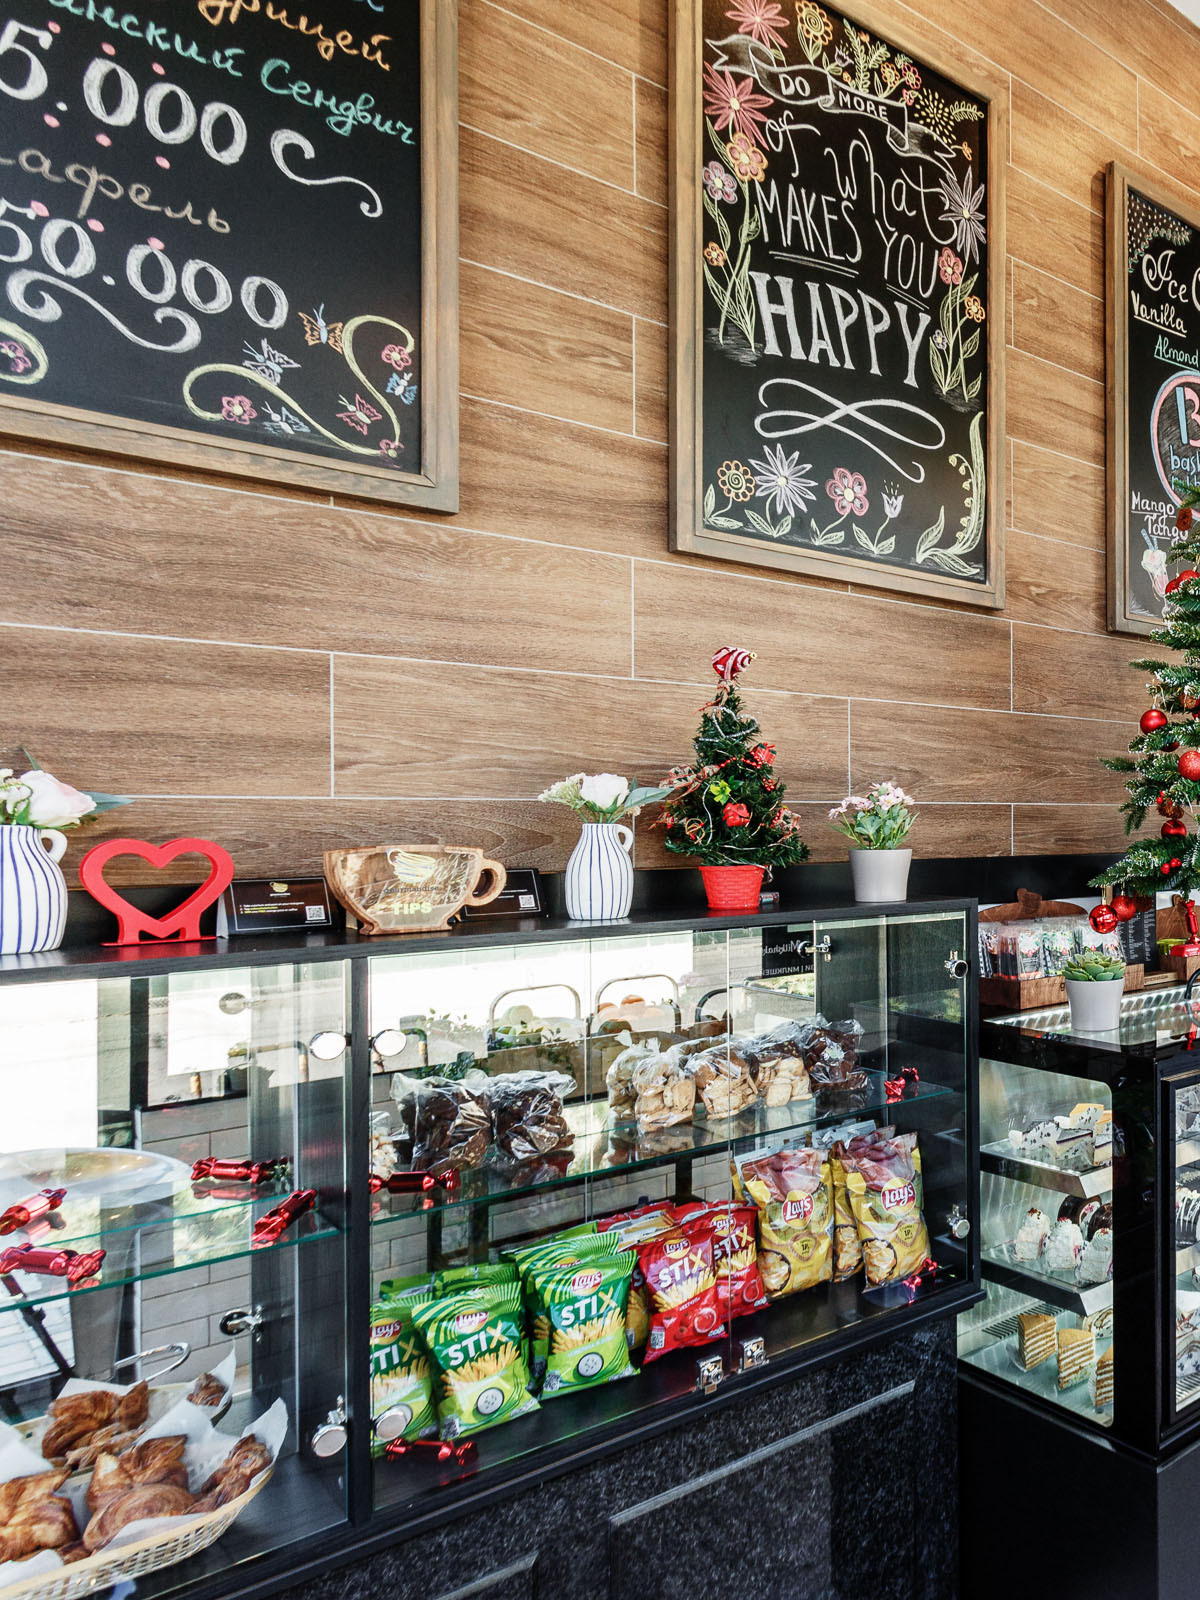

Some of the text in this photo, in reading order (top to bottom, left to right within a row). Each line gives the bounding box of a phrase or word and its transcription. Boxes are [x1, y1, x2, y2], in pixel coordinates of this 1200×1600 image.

[780, 72, 888, 121] DO MORE
[765, 110, 821, 177] of
[0, 149, 231, 234] афель
[755, 178, 940, 299] MAKES YOU
[1141, 249, 1189, 303] Ice
[748, 270, 933, 389] HAPPY
[1130, 289, 1188, 335] Vanilla
[1131, 490, 1176, 527] Mango
[391, 902, 433, 916] TIPS
[658, 1247, 708, 1289] STIX
[560, 1285, 618, 1327] STIX
[448, 1319, 509, 1367] STIX
